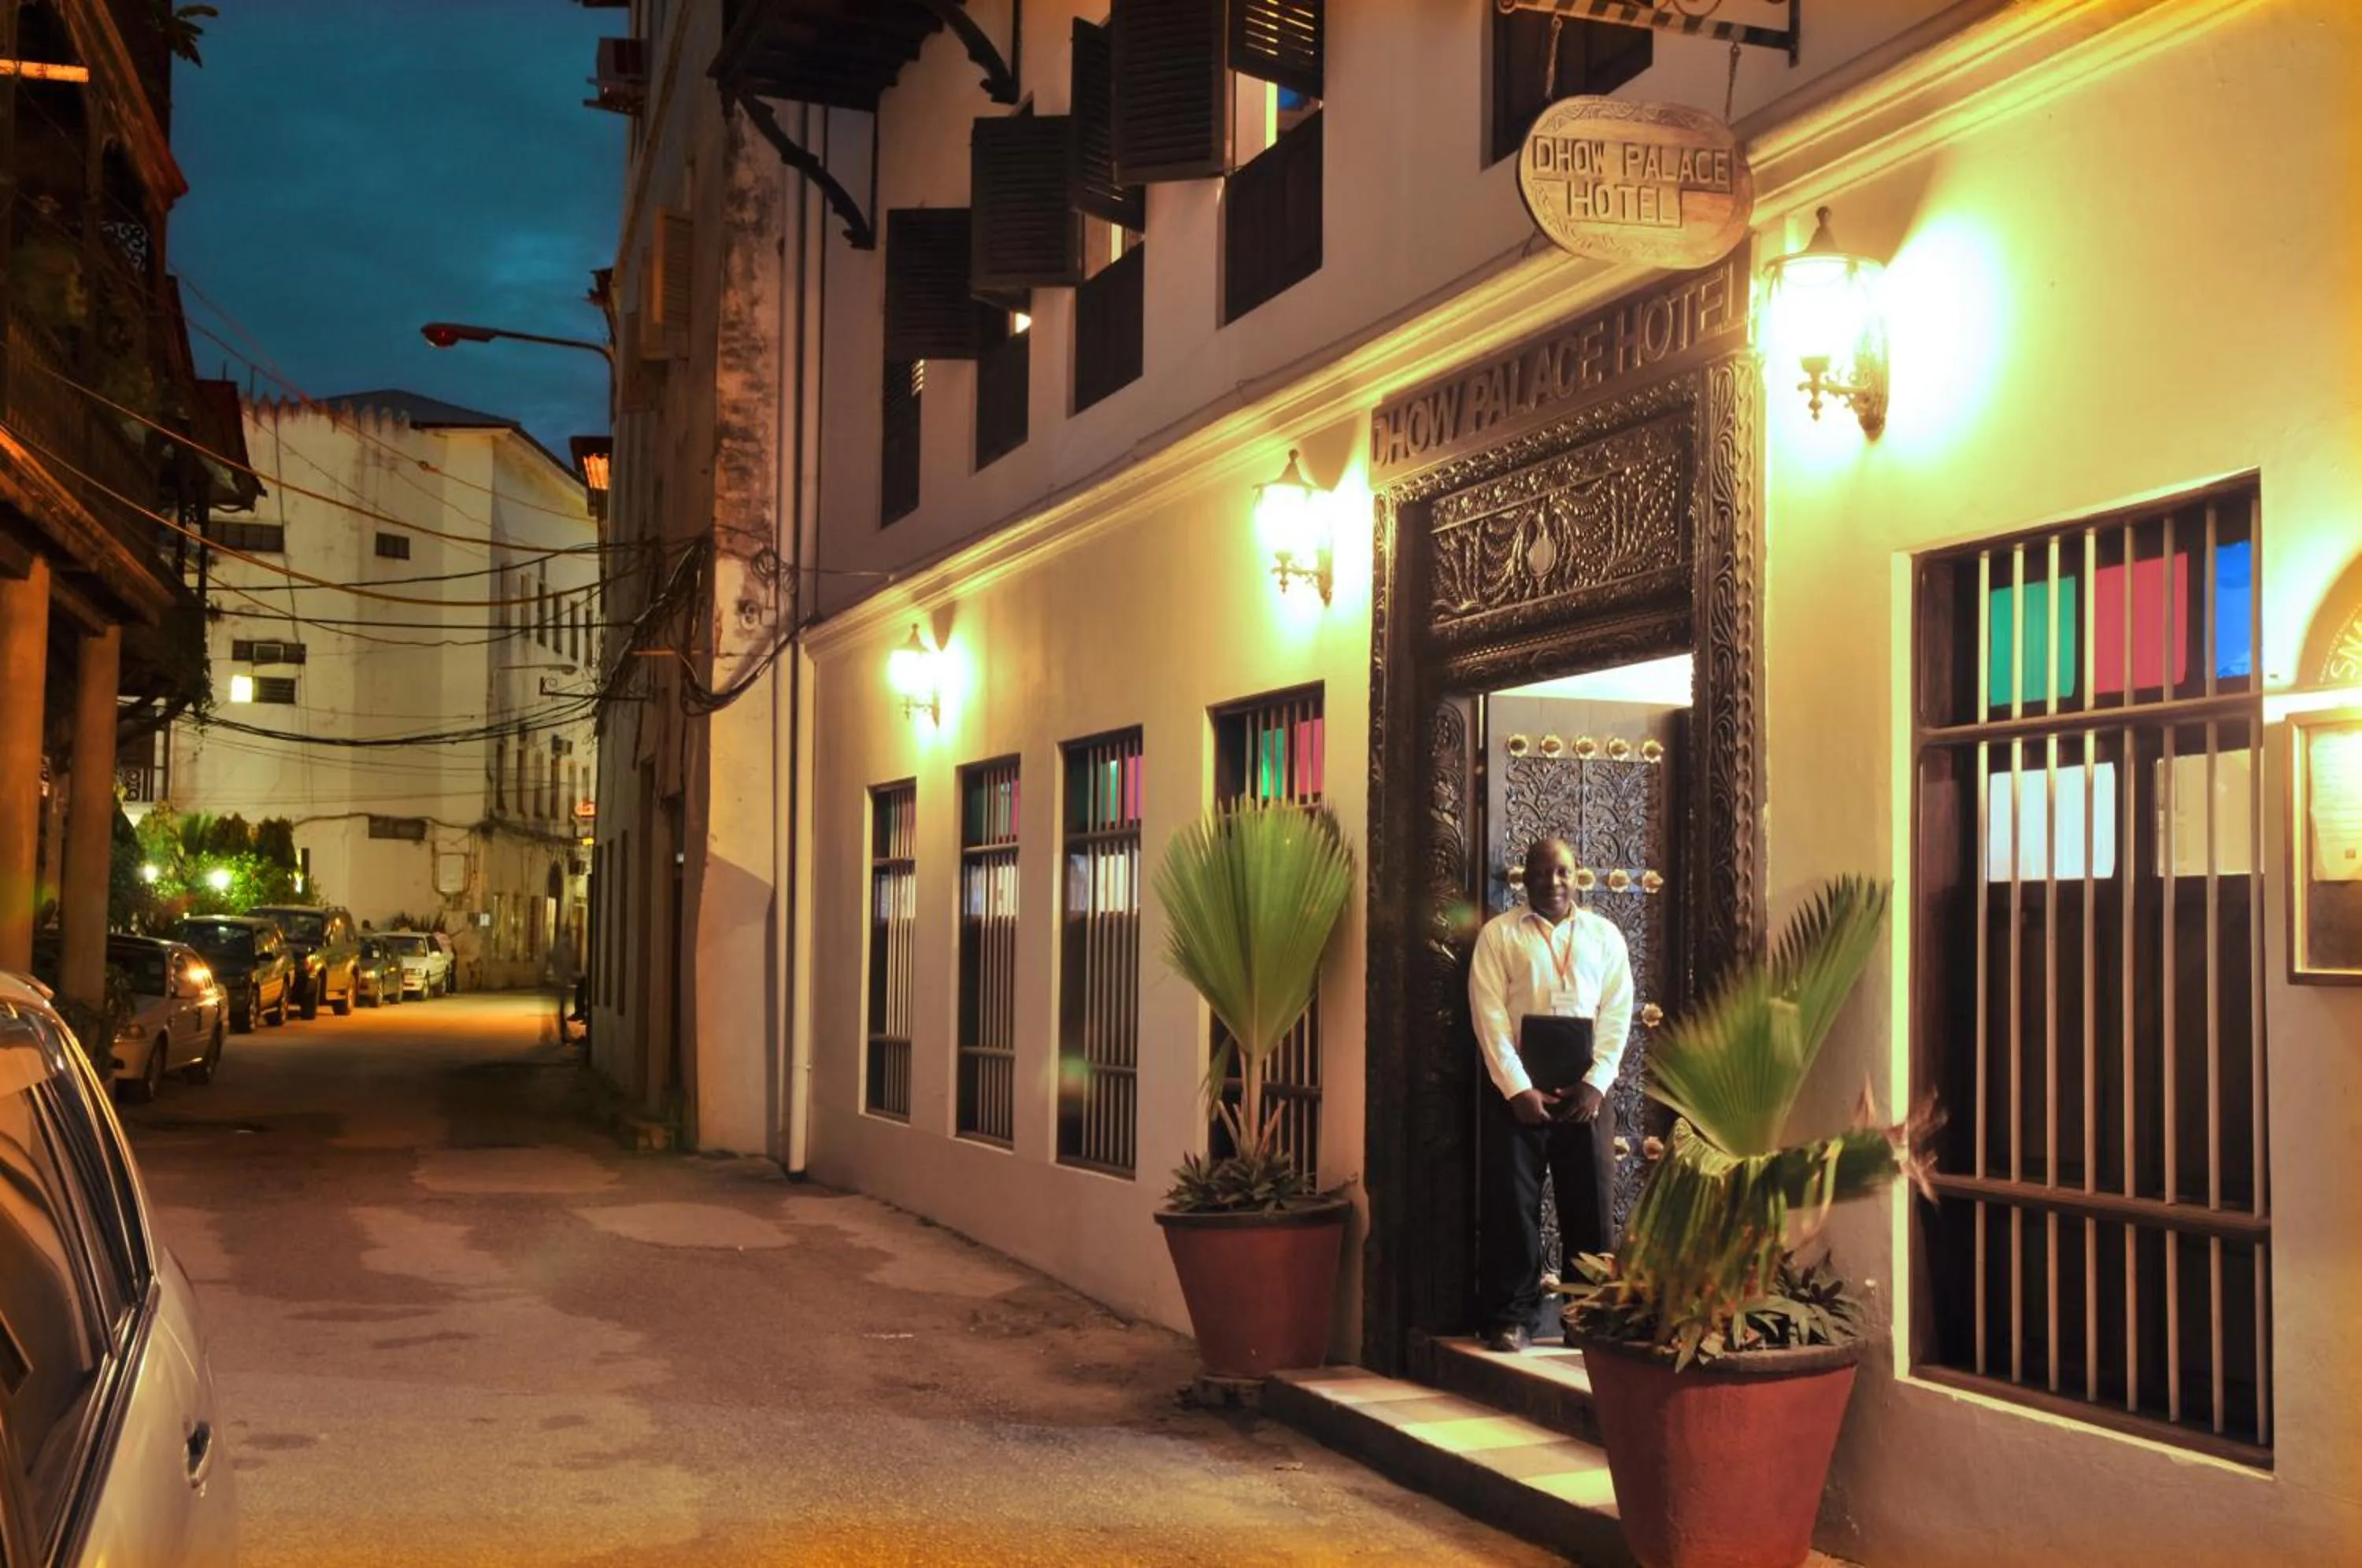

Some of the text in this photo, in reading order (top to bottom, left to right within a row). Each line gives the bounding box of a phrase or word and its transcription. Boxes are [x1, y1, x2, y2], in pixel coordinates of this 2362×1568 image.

[1534, 136, 1729, 184] DHOW PALACE
[1568, 181, 1678, 223] HOTEL
[1372, 261, 1741, 467] DHOW PALACE HOTEL
